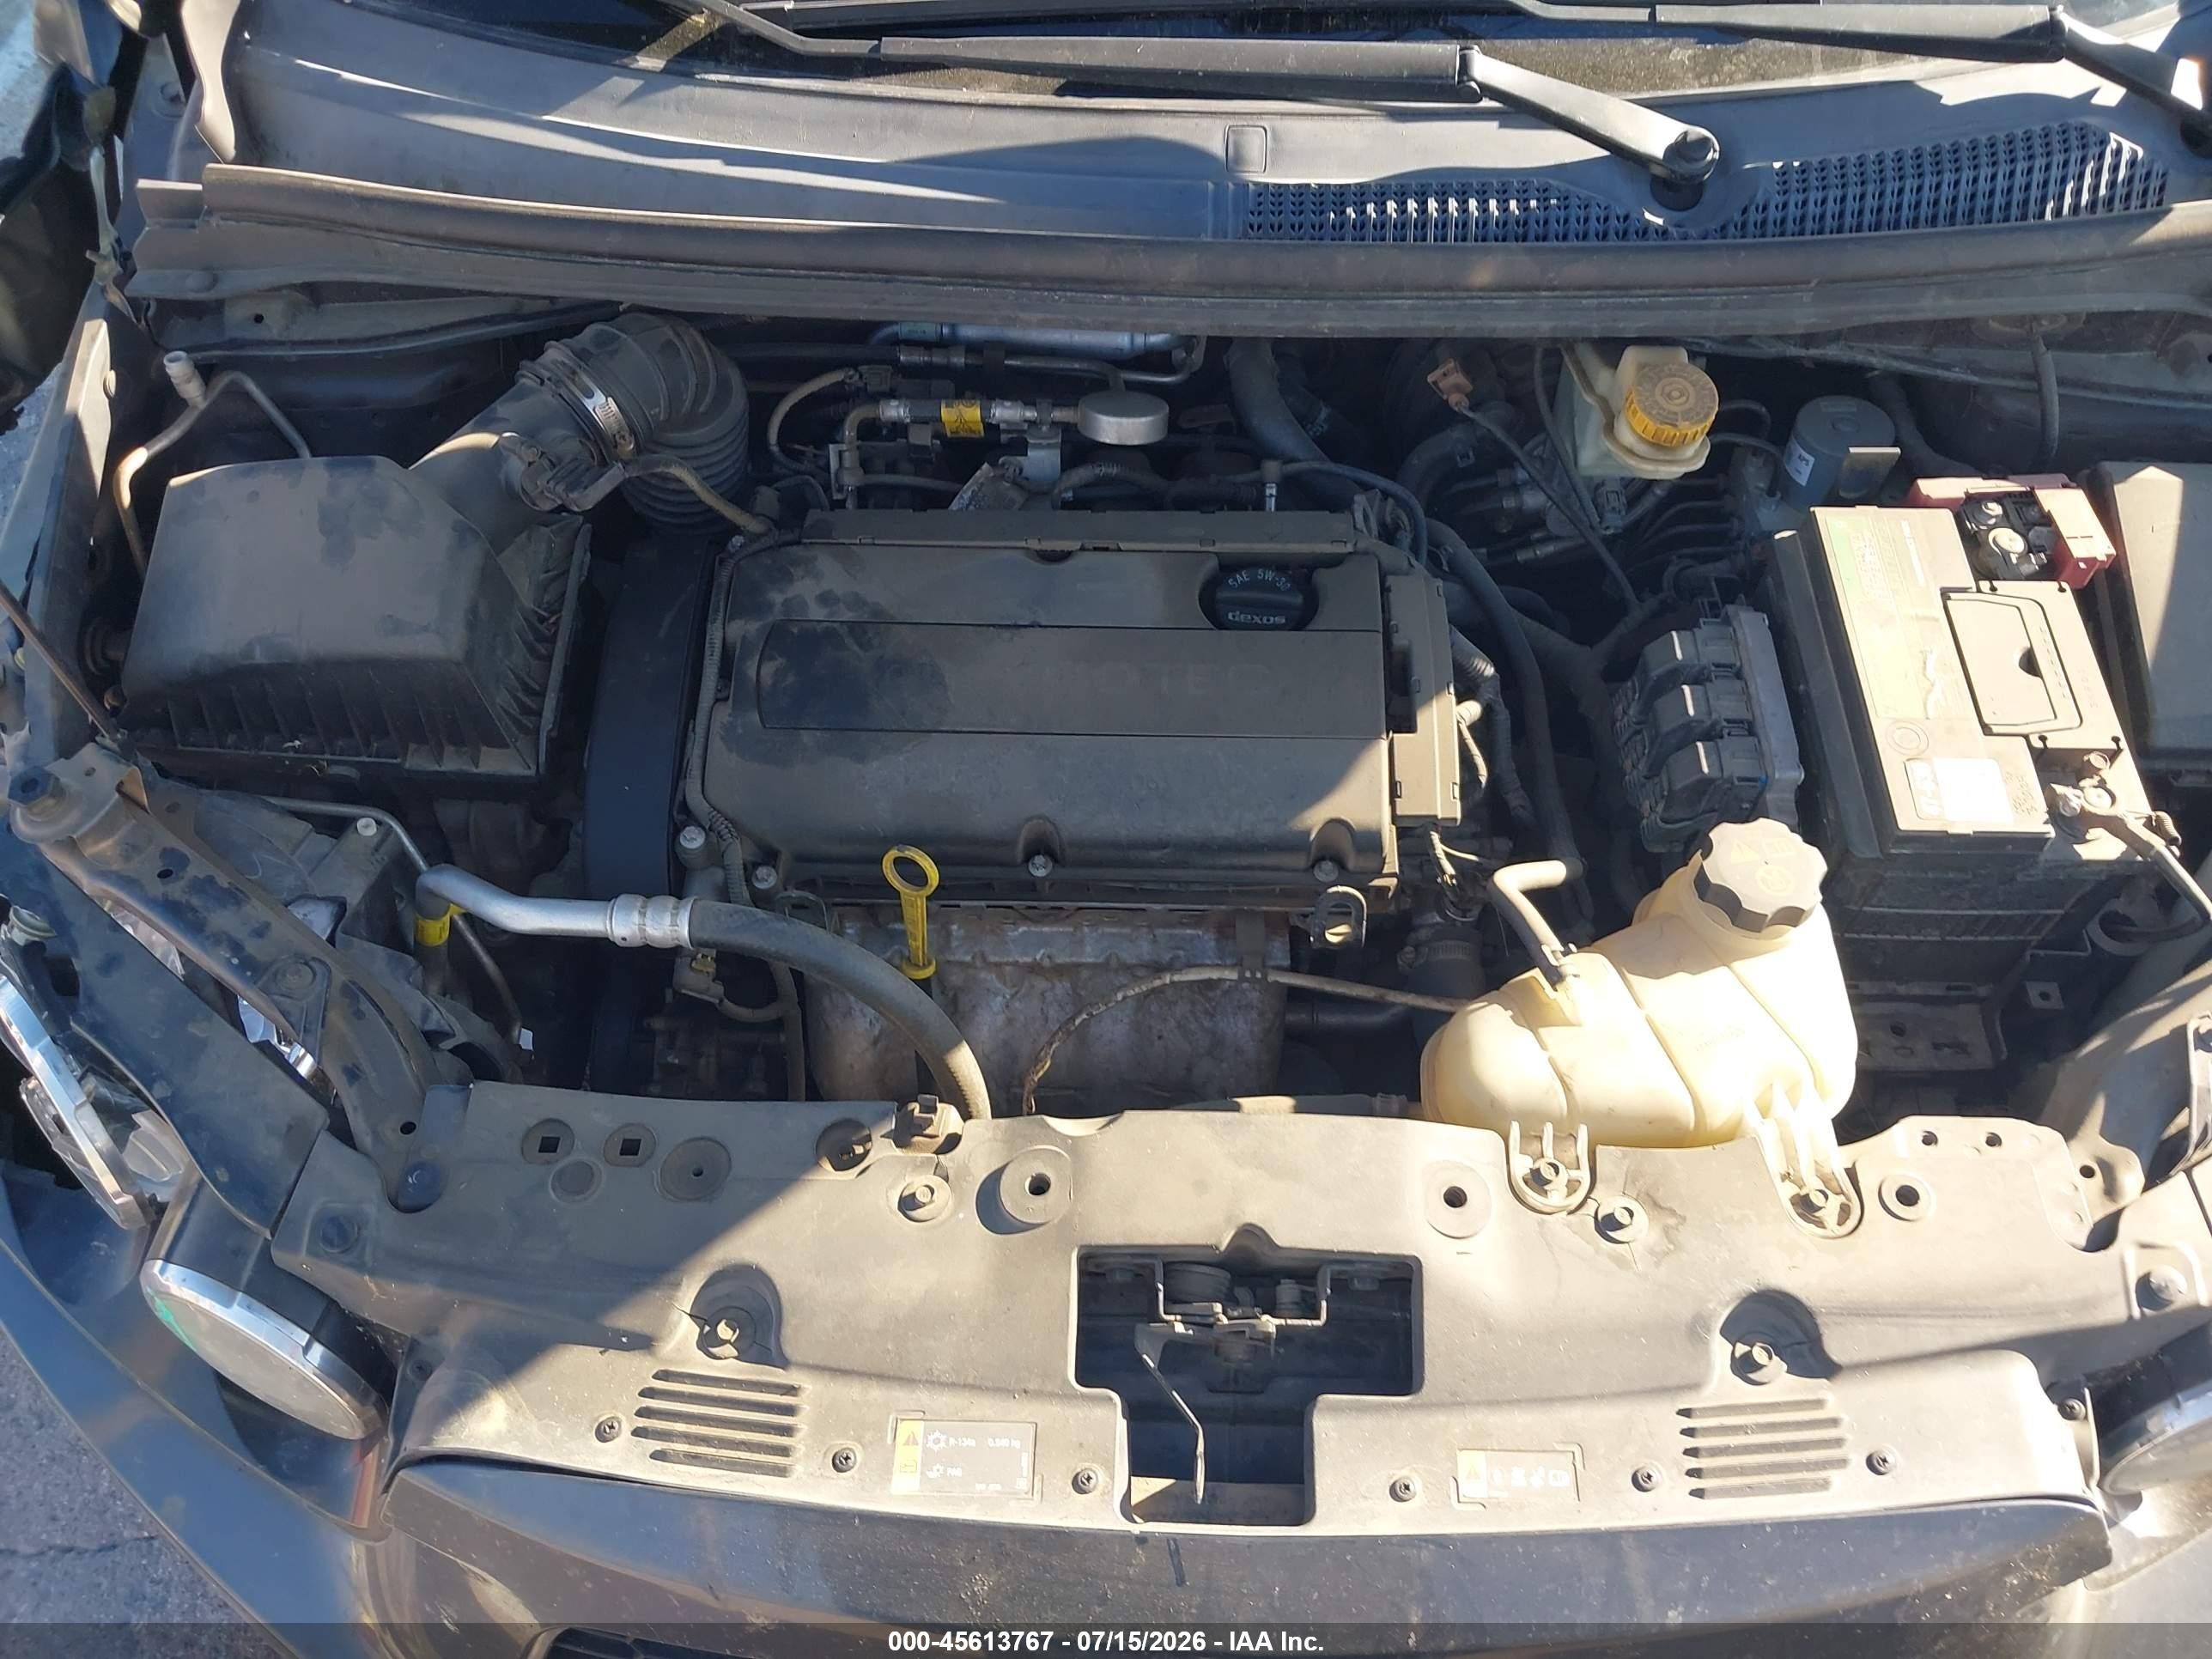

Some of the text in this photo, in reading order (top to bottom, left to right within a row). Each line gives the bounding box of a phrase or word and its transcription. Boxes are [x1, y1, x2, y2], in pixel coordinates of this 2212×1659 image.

[1228, 568, 1291, 592] SAE 5W-30
[1228, 611, 1285, 625] dexos
